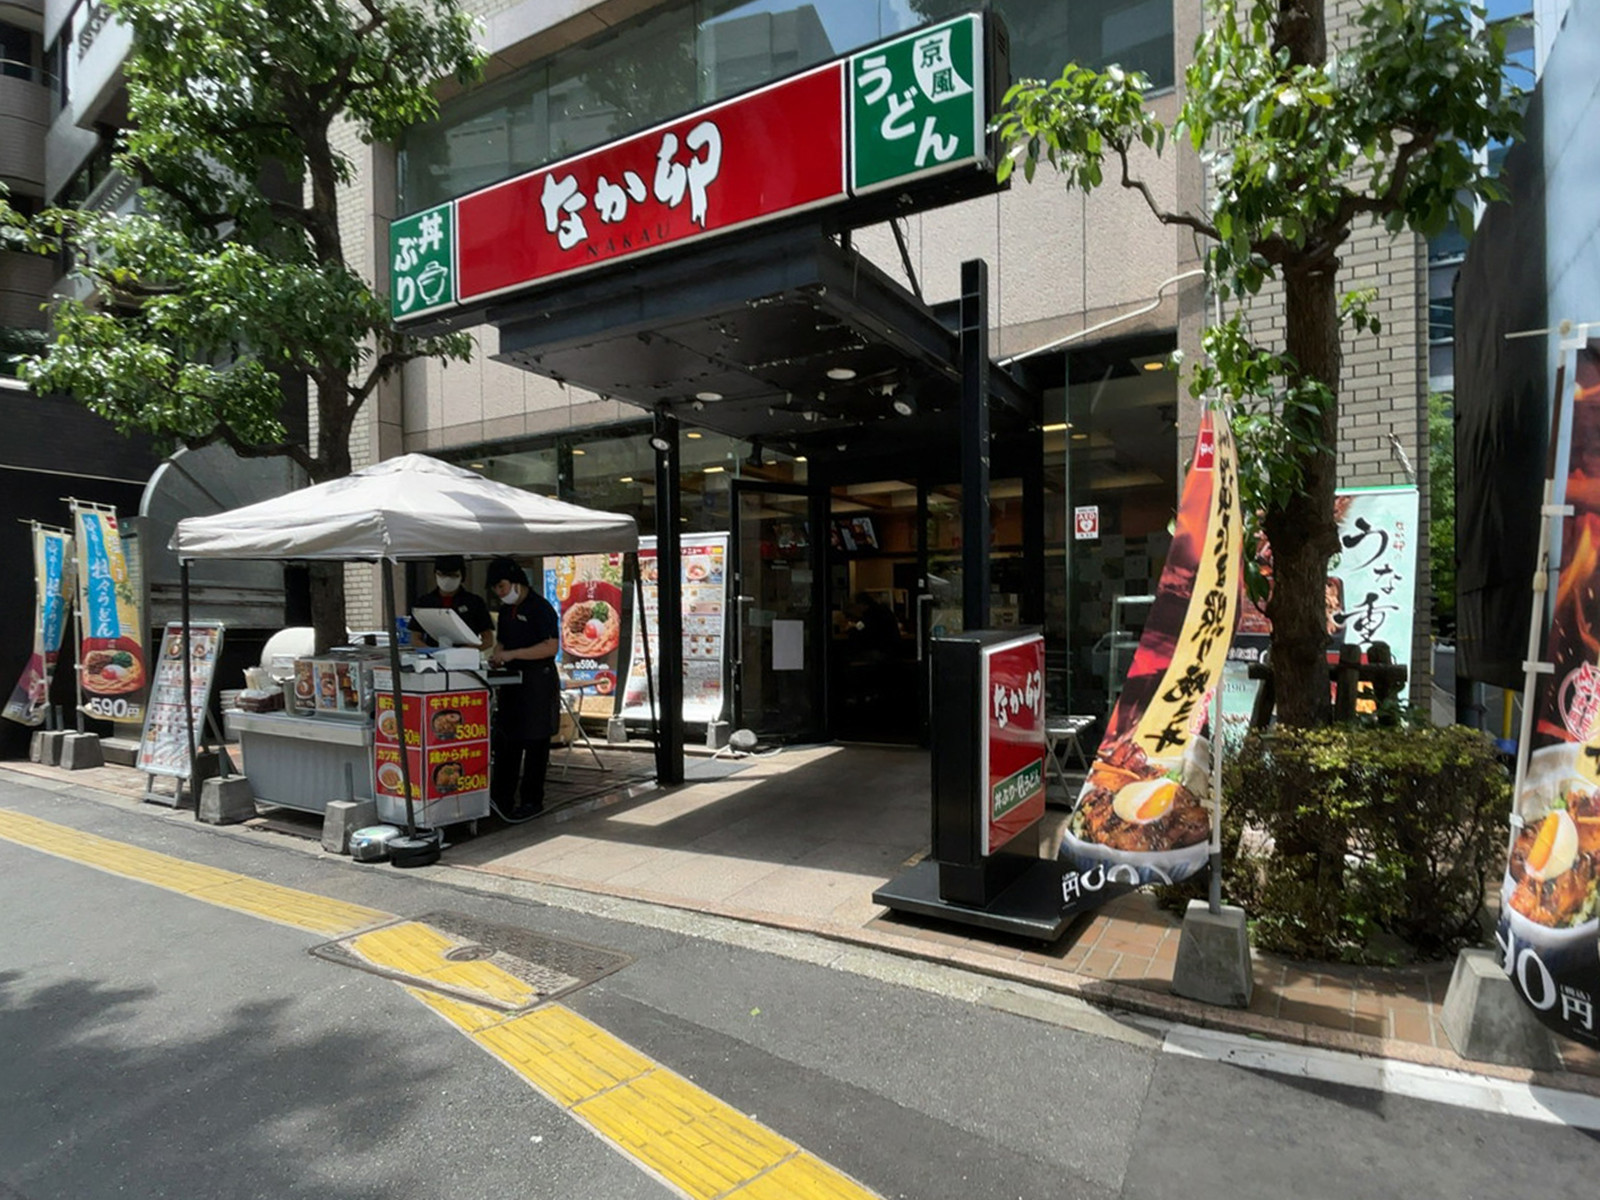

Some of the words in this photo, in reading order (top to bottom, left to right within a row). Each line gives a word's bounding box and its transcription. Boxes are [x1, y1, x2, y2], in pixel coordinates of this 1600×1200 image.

[919, 38, 959, 100] 京風
[856, 54, 959, 167] うどん
[540, 120, 722, 251] なか卯
[586, 220, 670, 258] NAKAU
[1333, 517, 1402, 645] うな重
[91, 697, 140, 718] 590円
[993, 669, 1042, 729] なか卯
[456, 723, 487, 740] 530円
[457, 775, 487, 791] 590円
